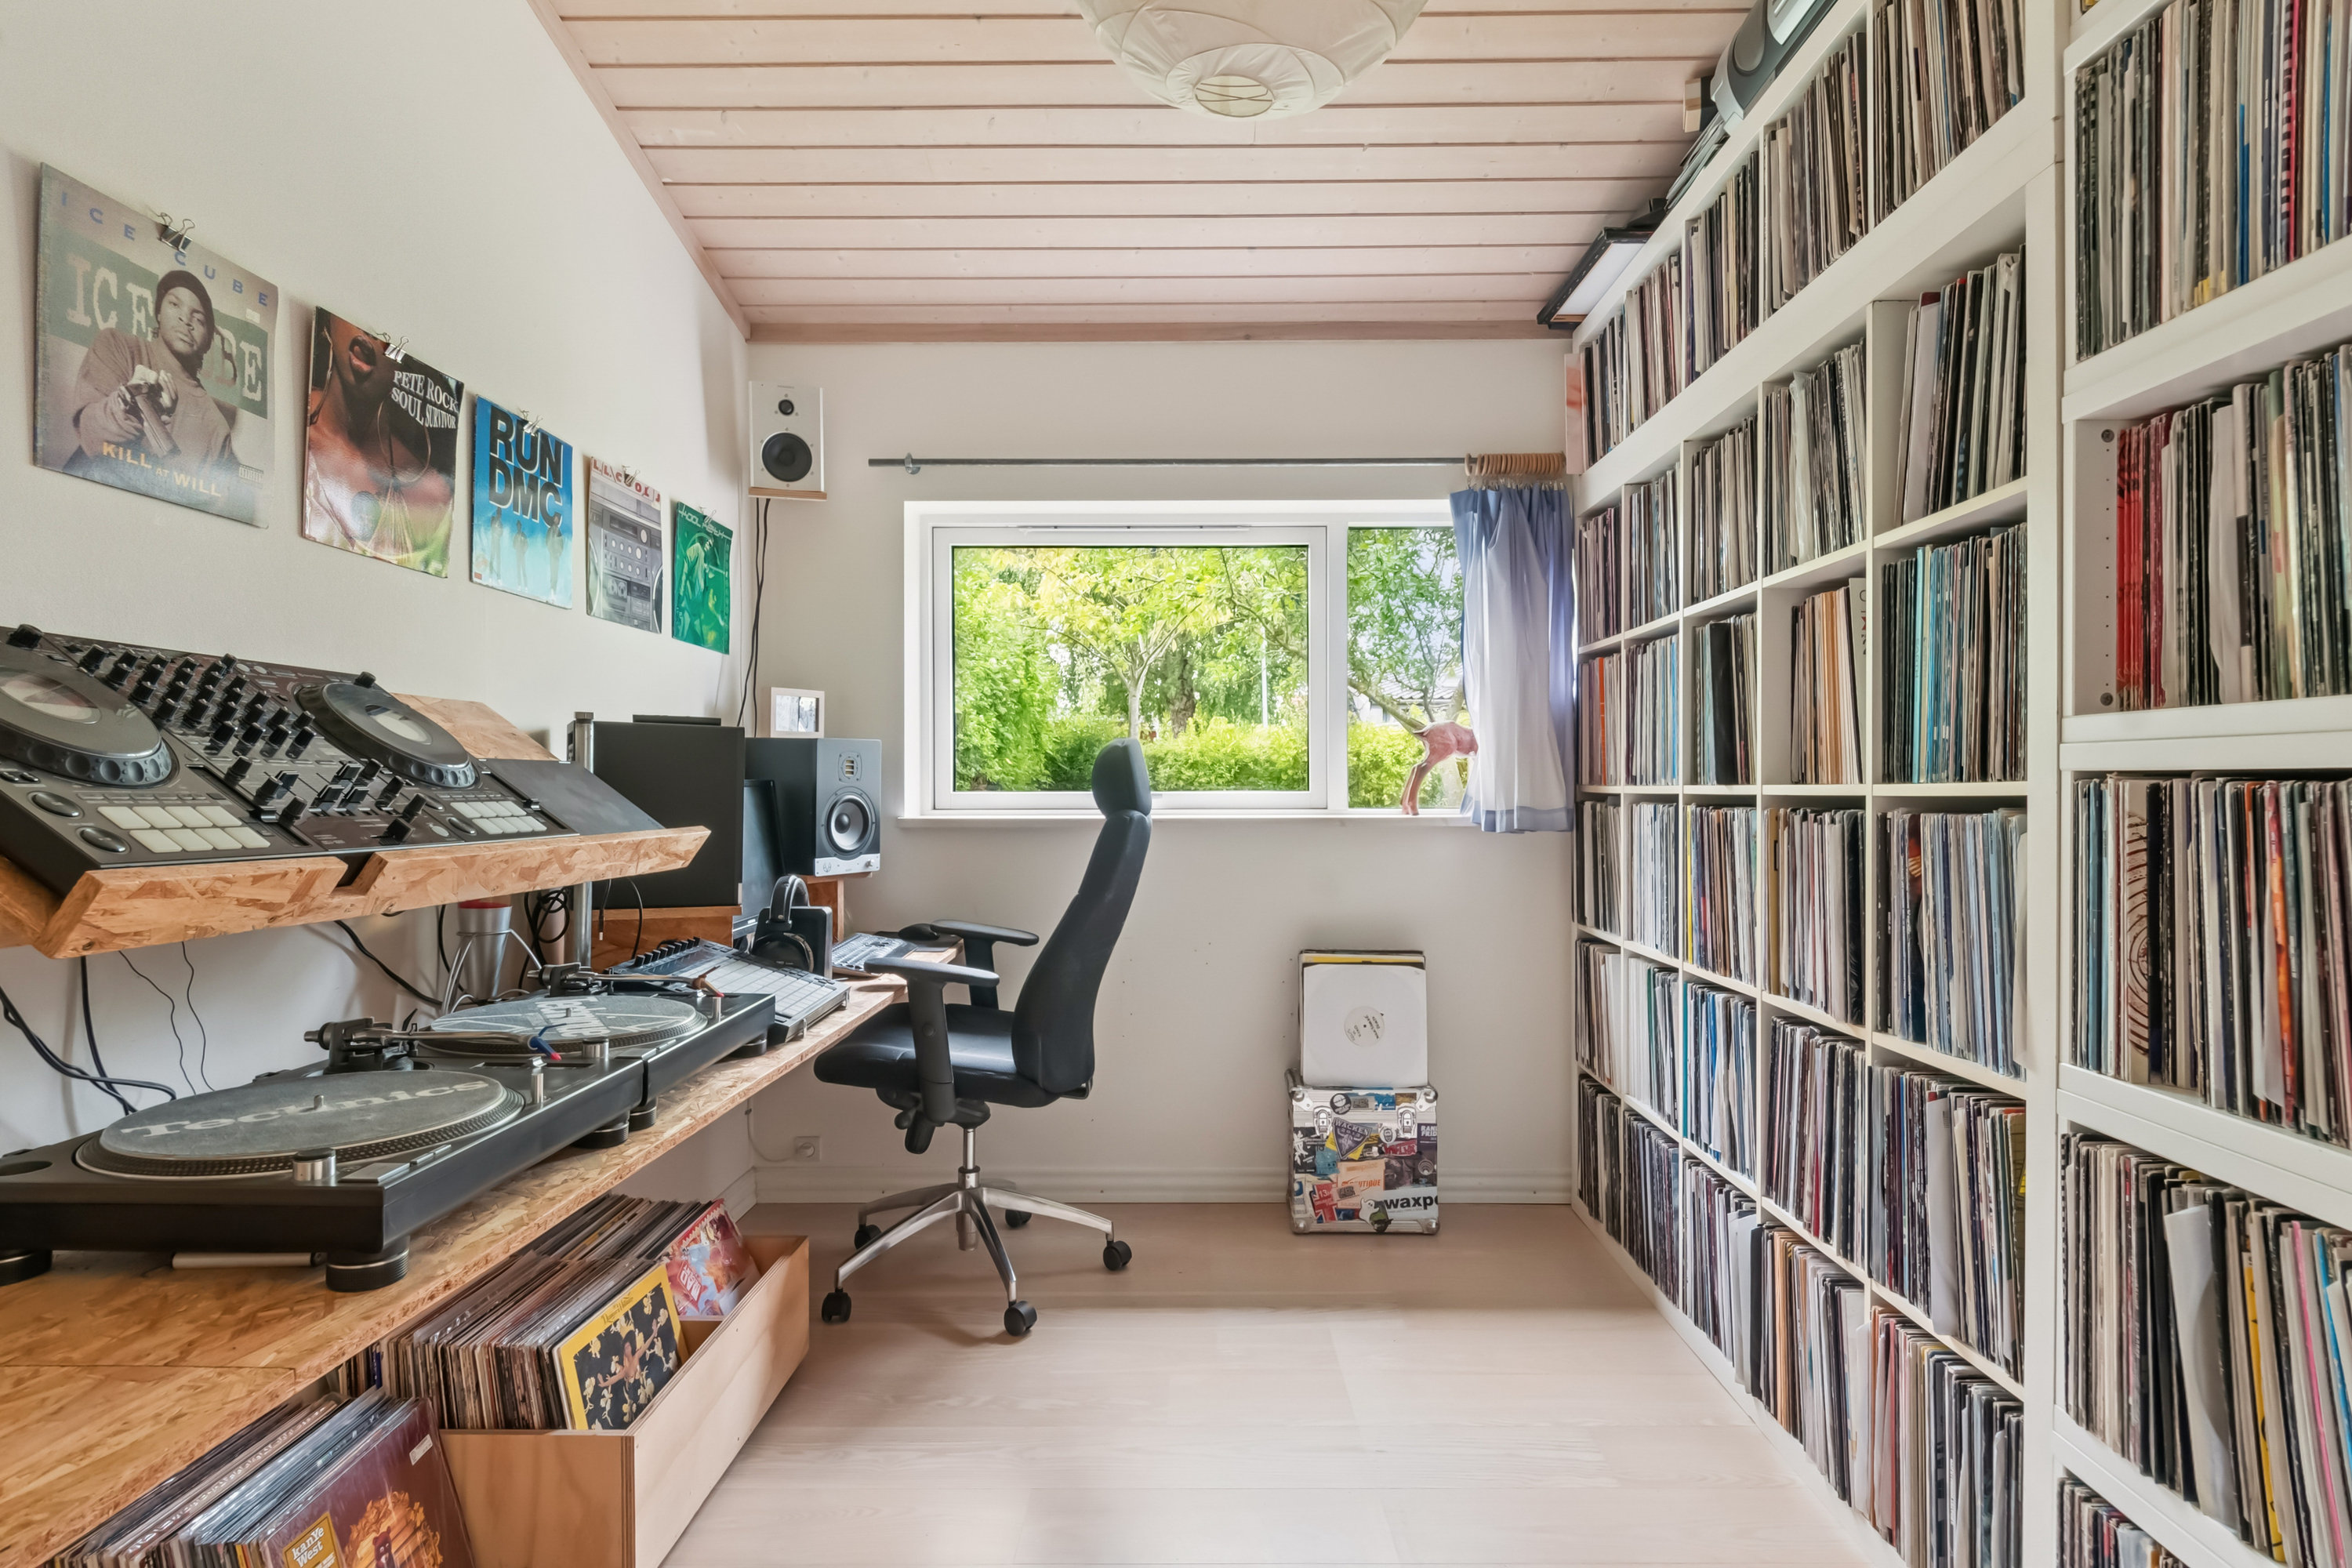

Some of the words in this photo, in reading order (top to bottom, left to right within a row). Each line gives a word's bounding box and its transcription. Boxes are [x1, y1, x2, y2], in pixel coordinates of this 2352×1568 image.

[61, 192, 136, 241] ICE
[174, 251, 269, 307] CUBE
[67, 254, 154, 340] ICE
[391, 387, 425, 426] SOUL
[425, 403, 456, 430] SURVIVOR
[394, 370, 425, 397] PETE
[426, 377, 459, 413] ROCK
[103, 441, 153, 470] KILL
[156, 468, 168, 478] AT
[172, 471, 222, 498] WILL
[490, 405, 564, 489] RUN
[489, 455, 563, 528] DMC
[615, 472, 650, 498] COL
[121, 1080, 490, 1138] Technics
[1335, 1119, 1369, 1136] WACKEN
[295, 1540, 324, 1568] West
